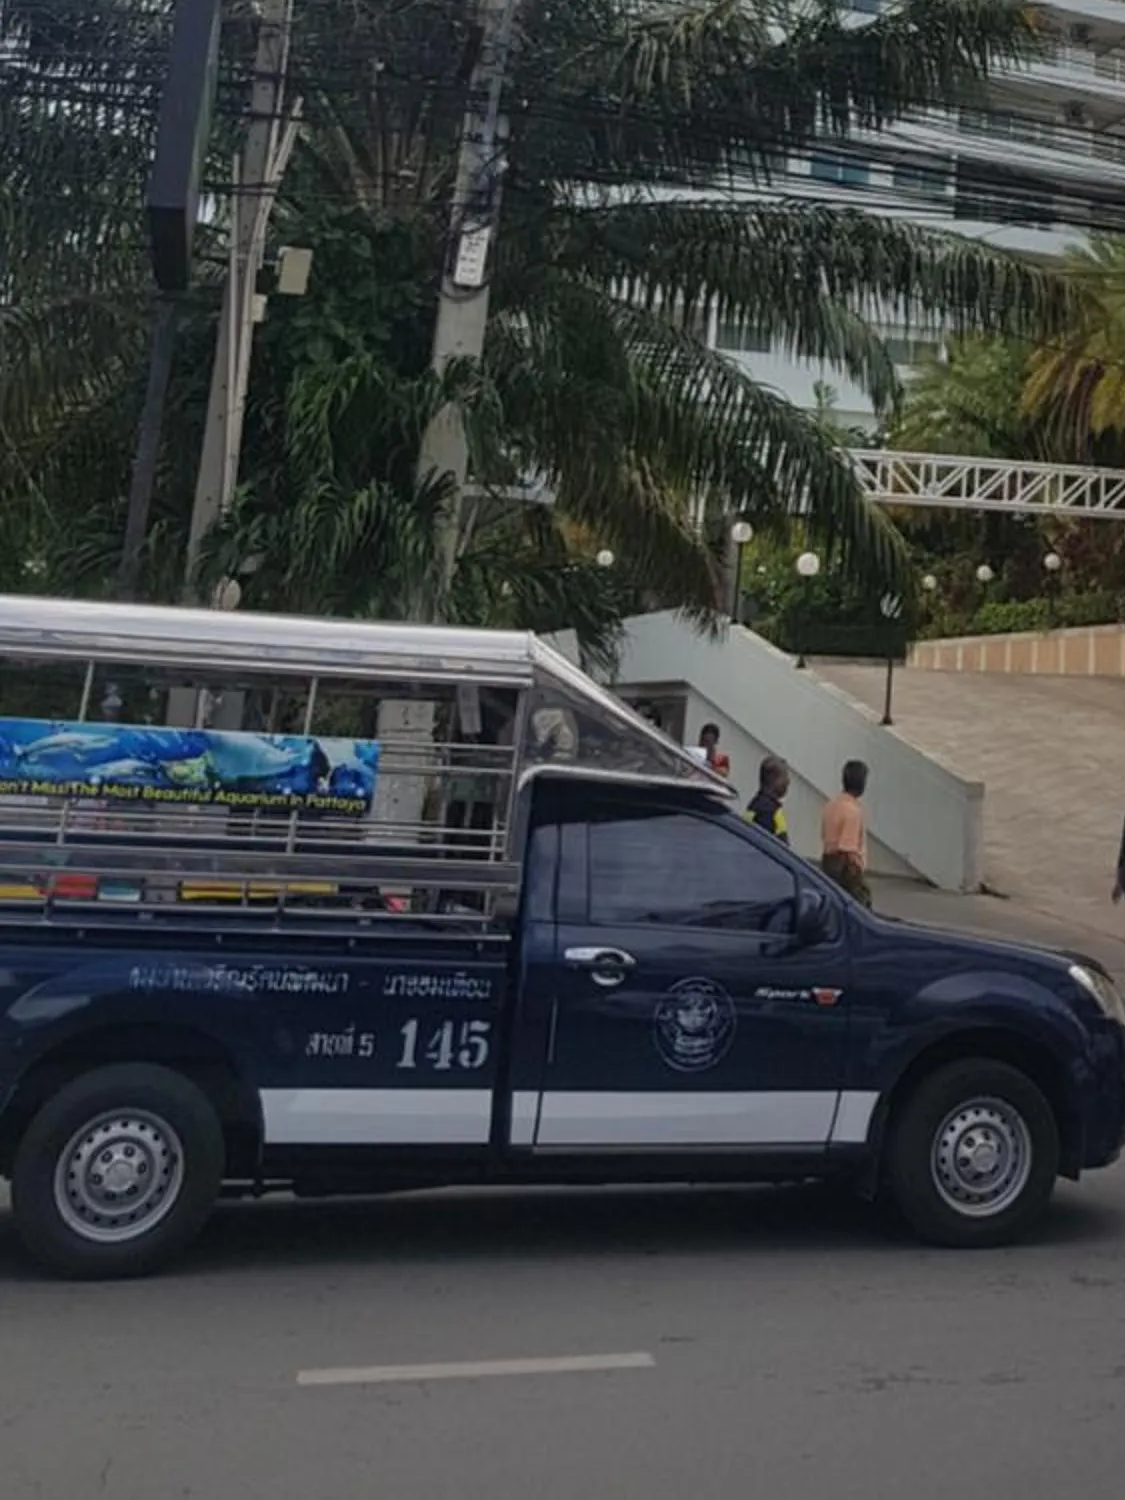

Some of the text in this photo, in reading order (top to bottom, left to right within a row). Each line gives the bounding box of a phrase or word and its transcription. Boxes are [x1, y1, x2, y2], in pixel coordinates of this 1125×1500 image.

[103, 784, 141, 798] Most
[142, 785, 213, 802] Beautiful
[215, 789, 290, 806] Aquarium
[305, 794, 367, 813] Pattaya
[358, 1031, 376, 1057] 5
[396, 1017, 492, 1070] 145
